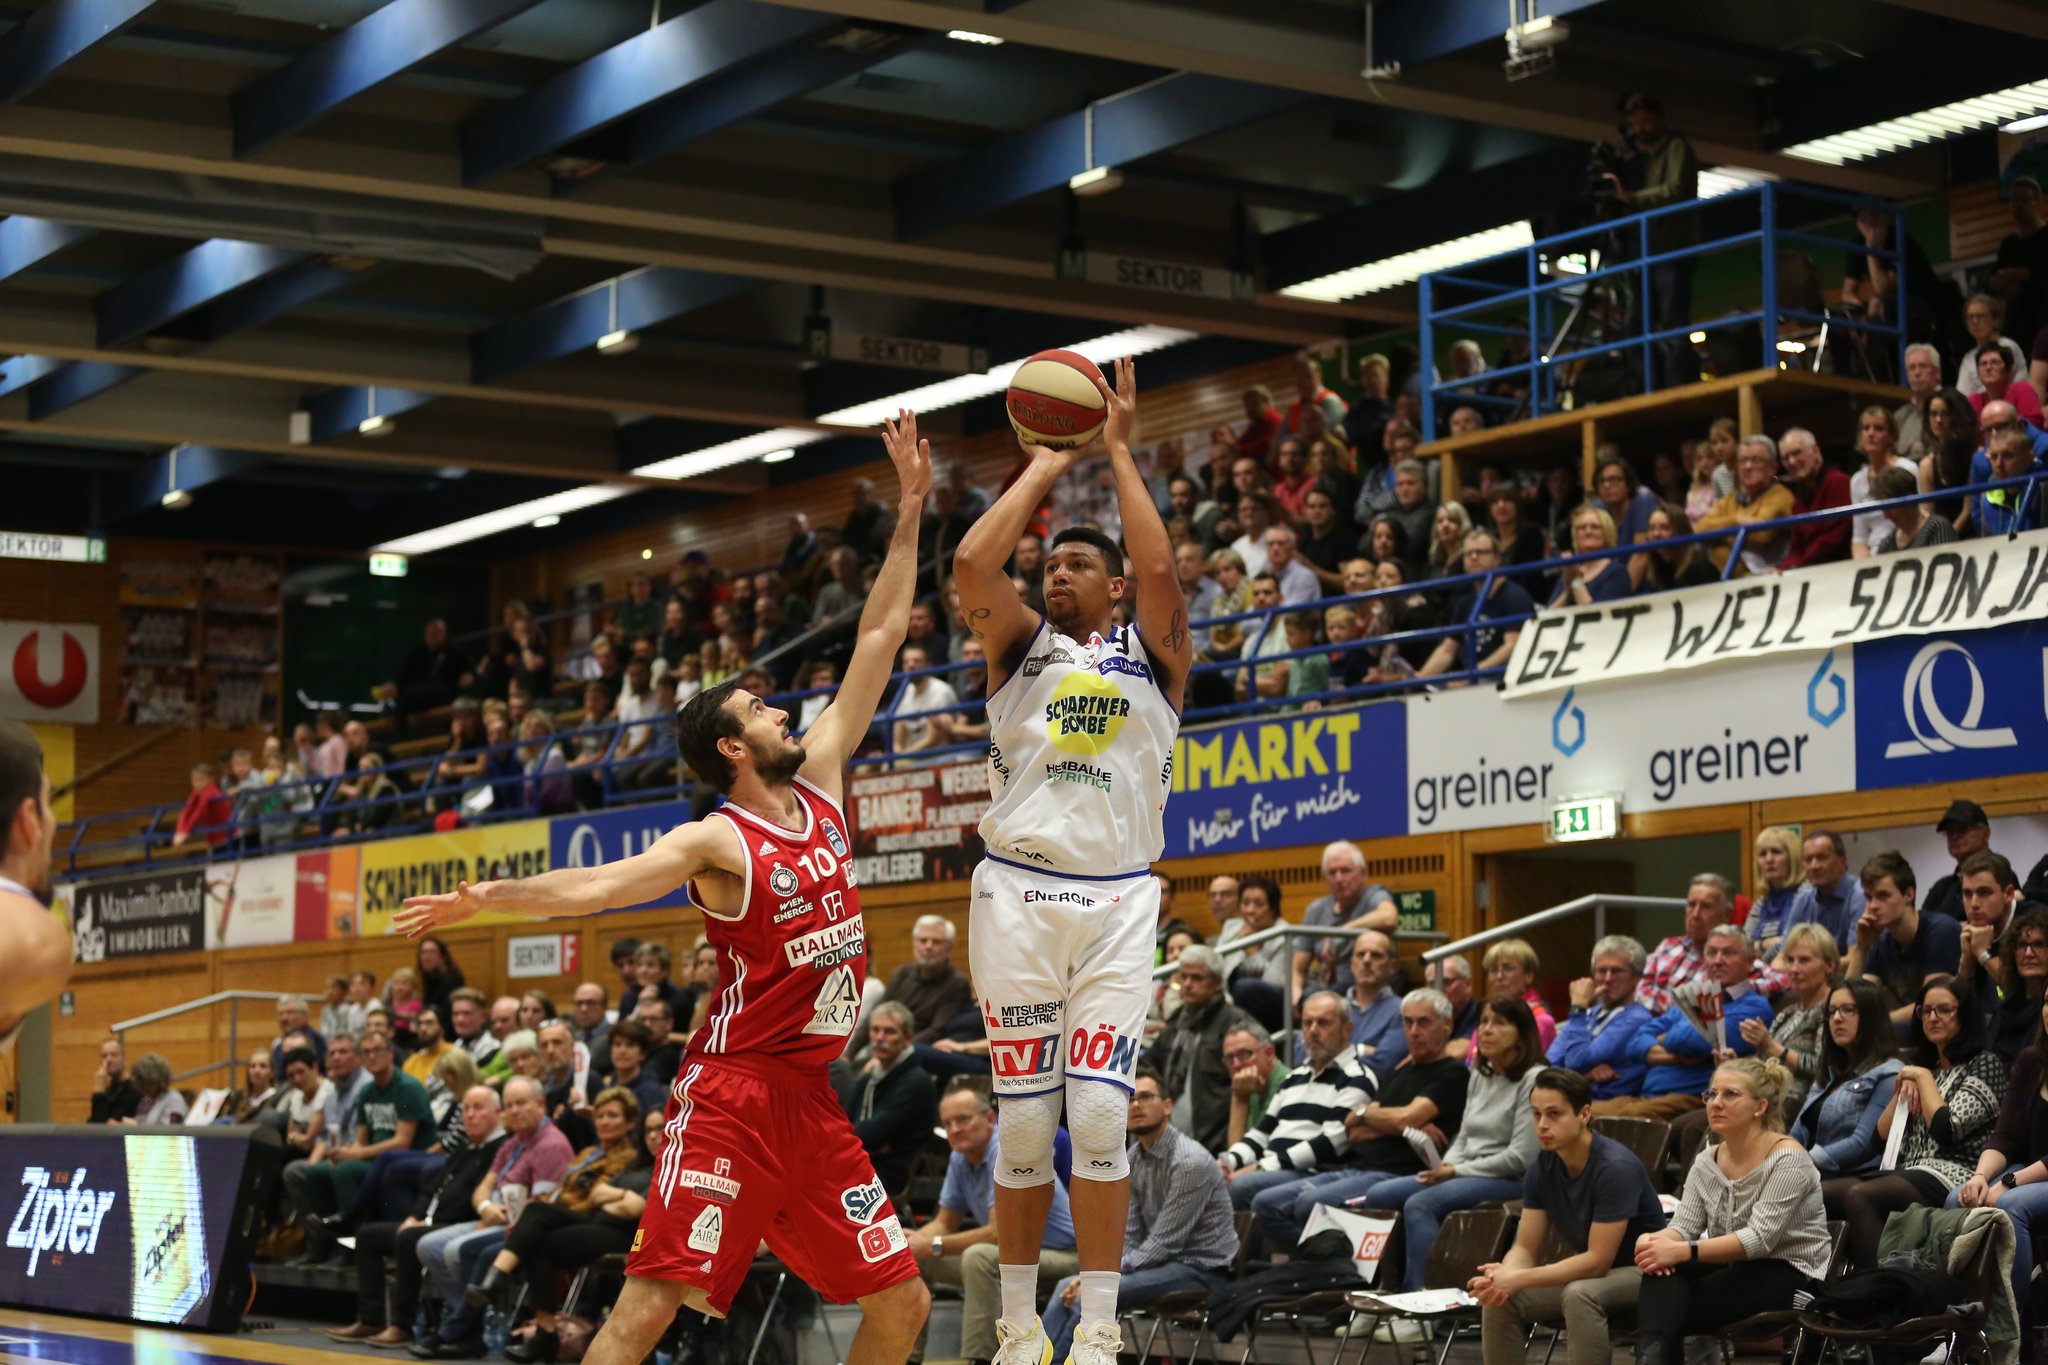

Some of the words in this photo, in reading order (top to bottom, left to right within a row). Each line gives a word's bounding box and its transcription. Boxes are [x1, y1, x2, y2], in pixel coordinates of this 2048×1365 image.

[1117, 258, 1203, 290] SEKTOR
[860, 336, 943, 367] SEKTOR
[1517, 604, 1651, 684] GET
[1665, 582, 1811, 661] WELL
[1832, 550, 1999, 638] SOON
[1046, 695, 1131, 722] SCHARTNER
[1061, 715, 1108, 735] BOMBE
[1046, 761, 1112, 783] HERBALIE
[1649, 728, 1809, 801] greiner
[1414, 757, 1553, 825] greiner
[1188, 809, 1245, 853] Mehr
[1249, 791, 1289, 844] für
[1296, 775, 1361, 821] mich
[797, 847, 838, 883] 10
[99, 876, 203, 923] Maximilianhof
[773, 902, 814, 924] ENERGIE
[779, 895, 804, 911] WIEN
[1024, 890, 1095, 907] ENERGIE
[109, 924, 191, 953] IMMOBILIEN
[514, 943, 555, 969] SEKTOR
[564, 933, 577, 973] F
[815, 940, 863, 969] HOLNG
[815, 1004, 853, 1025] AIRA
[1001, 1000, 1063, 1017] MITSUBISHI
[1002, 1012, 1057, 1028] ELECTRIC
[683, 1172, 738, 1195] HALLMANN
[6, 1166, 116, 1277] Zipfer
[693, 1229, 718, 1245] AIRA
